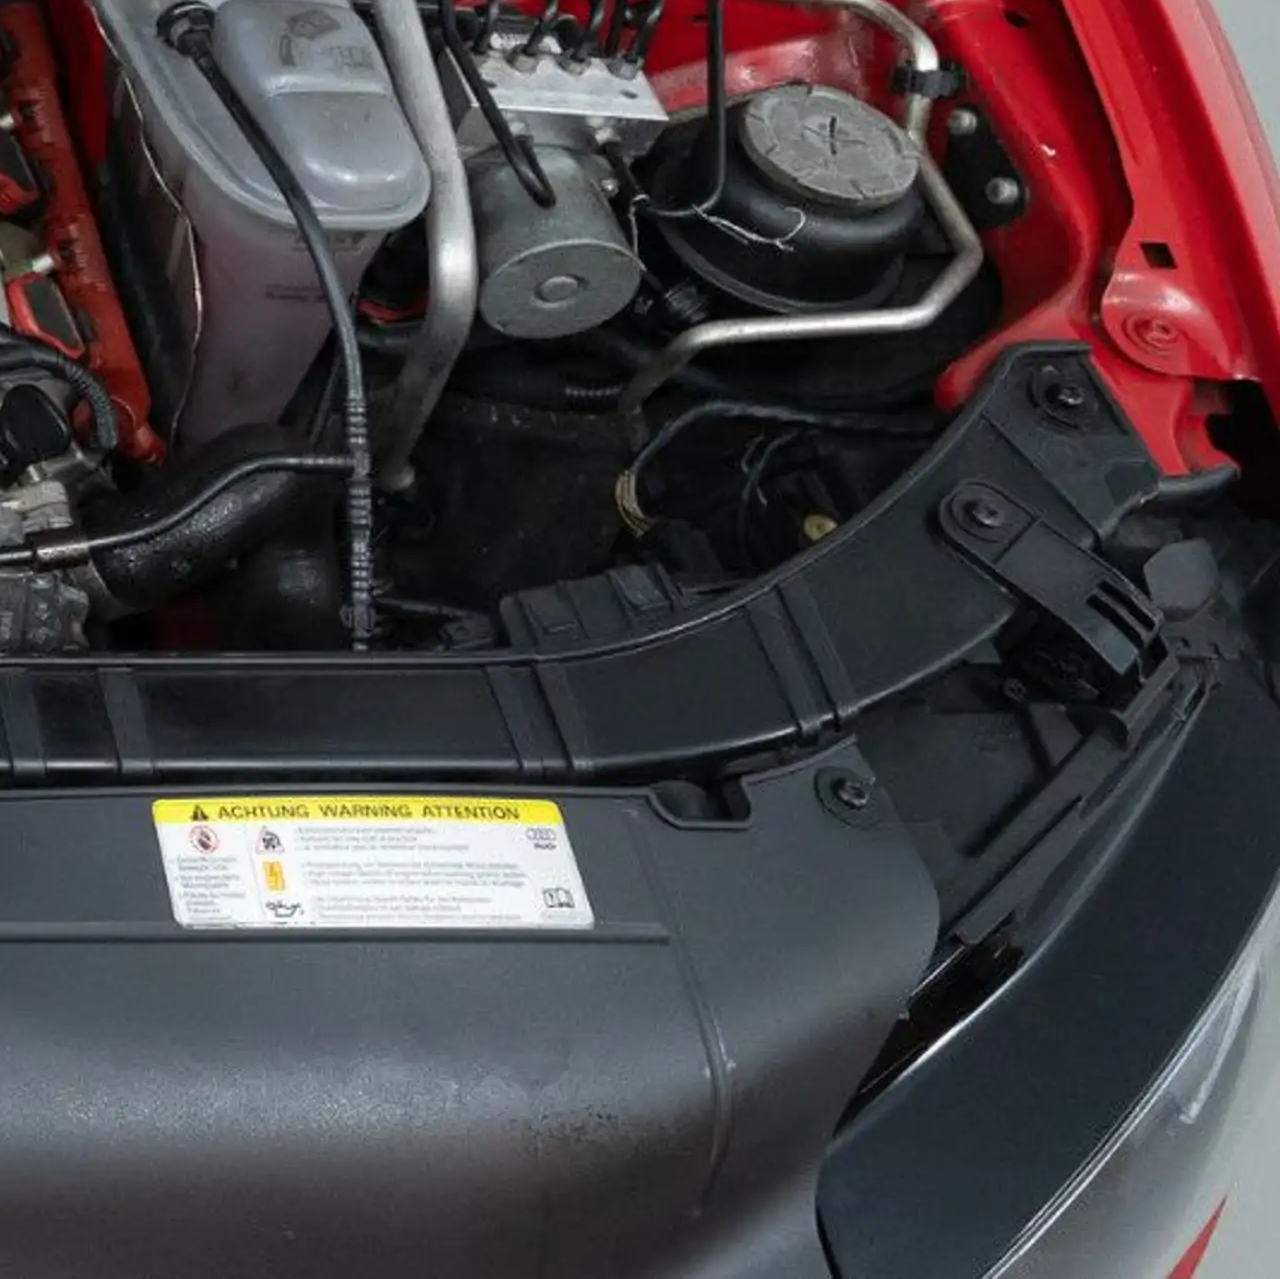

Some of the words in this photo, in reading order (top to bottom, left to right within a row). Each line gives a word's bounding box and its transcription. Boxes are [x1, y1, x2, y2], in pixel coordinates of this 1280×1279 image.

[218, 804, 310, 819] ACHTUNG
[318, 803, 413, 818] WARNING
[422, 804, 520, 820] ATTENTION
